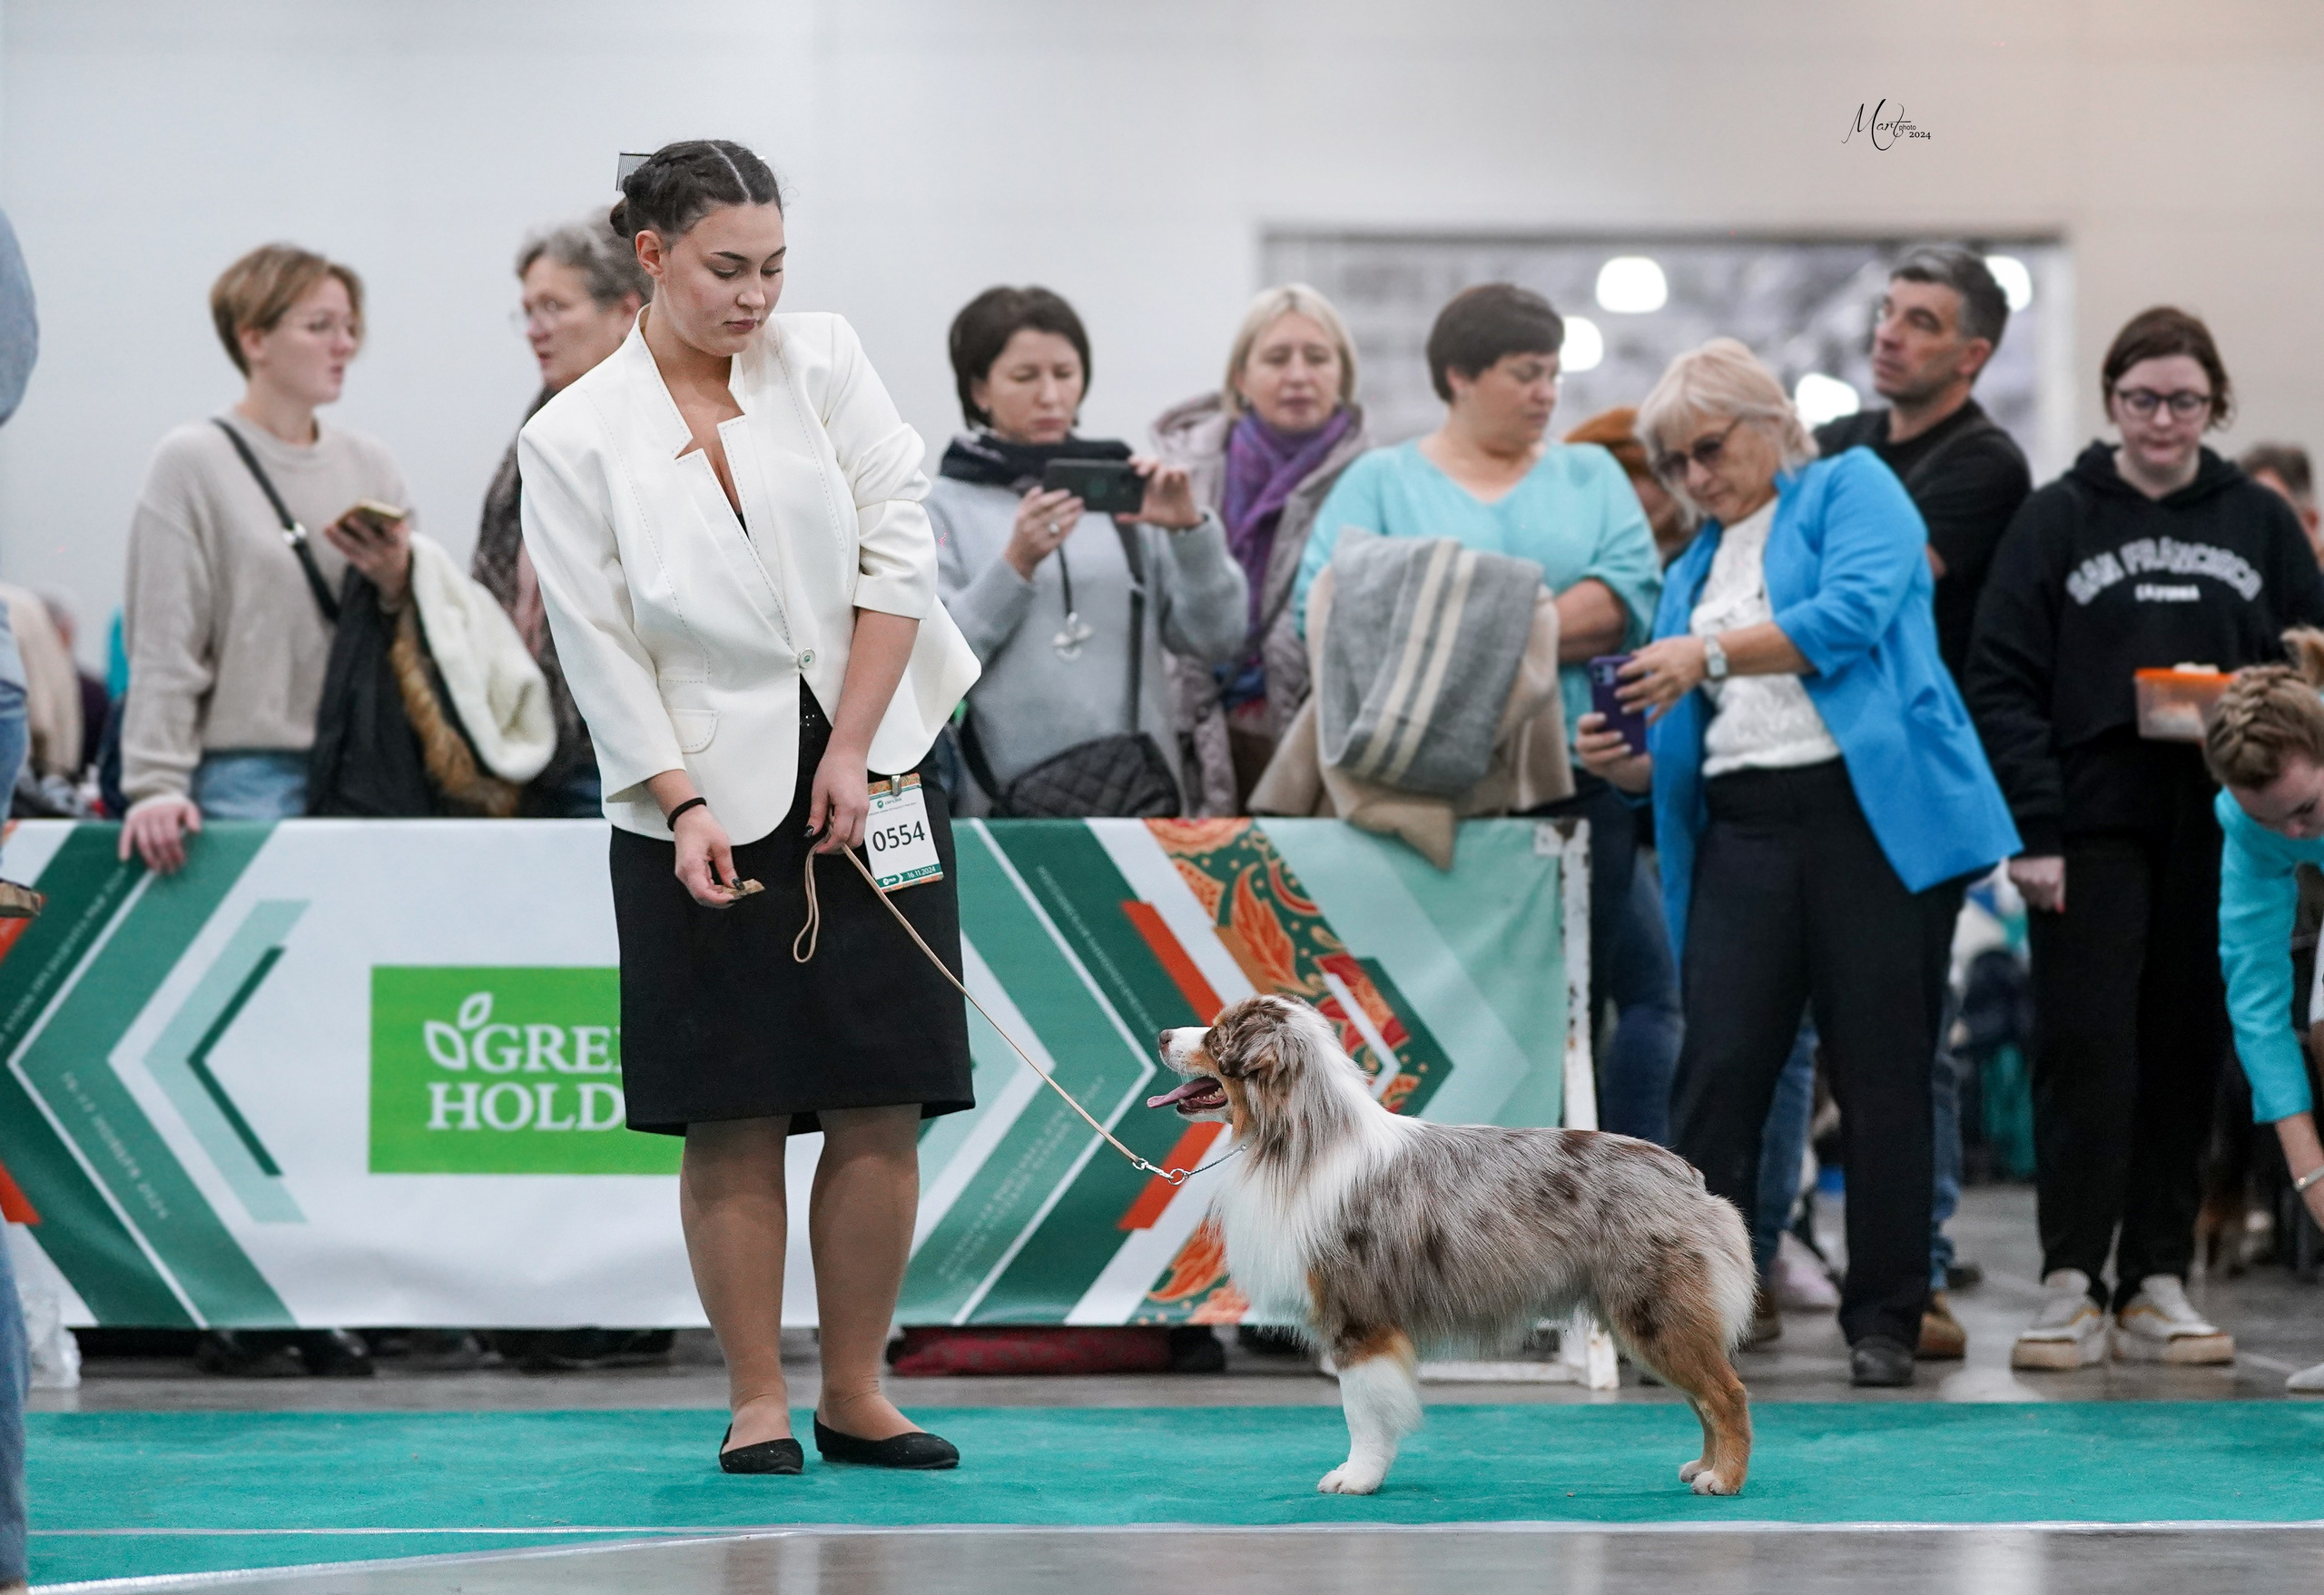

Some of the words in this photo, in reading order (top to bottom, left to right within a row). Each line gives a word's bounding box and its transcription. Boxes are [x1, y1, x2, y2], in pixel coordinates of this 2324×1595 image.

[2066, 552, 2125, 605] SAN
[872, 820, 925, 852] 0554
[471, 1023, 622, 1074] GRE
